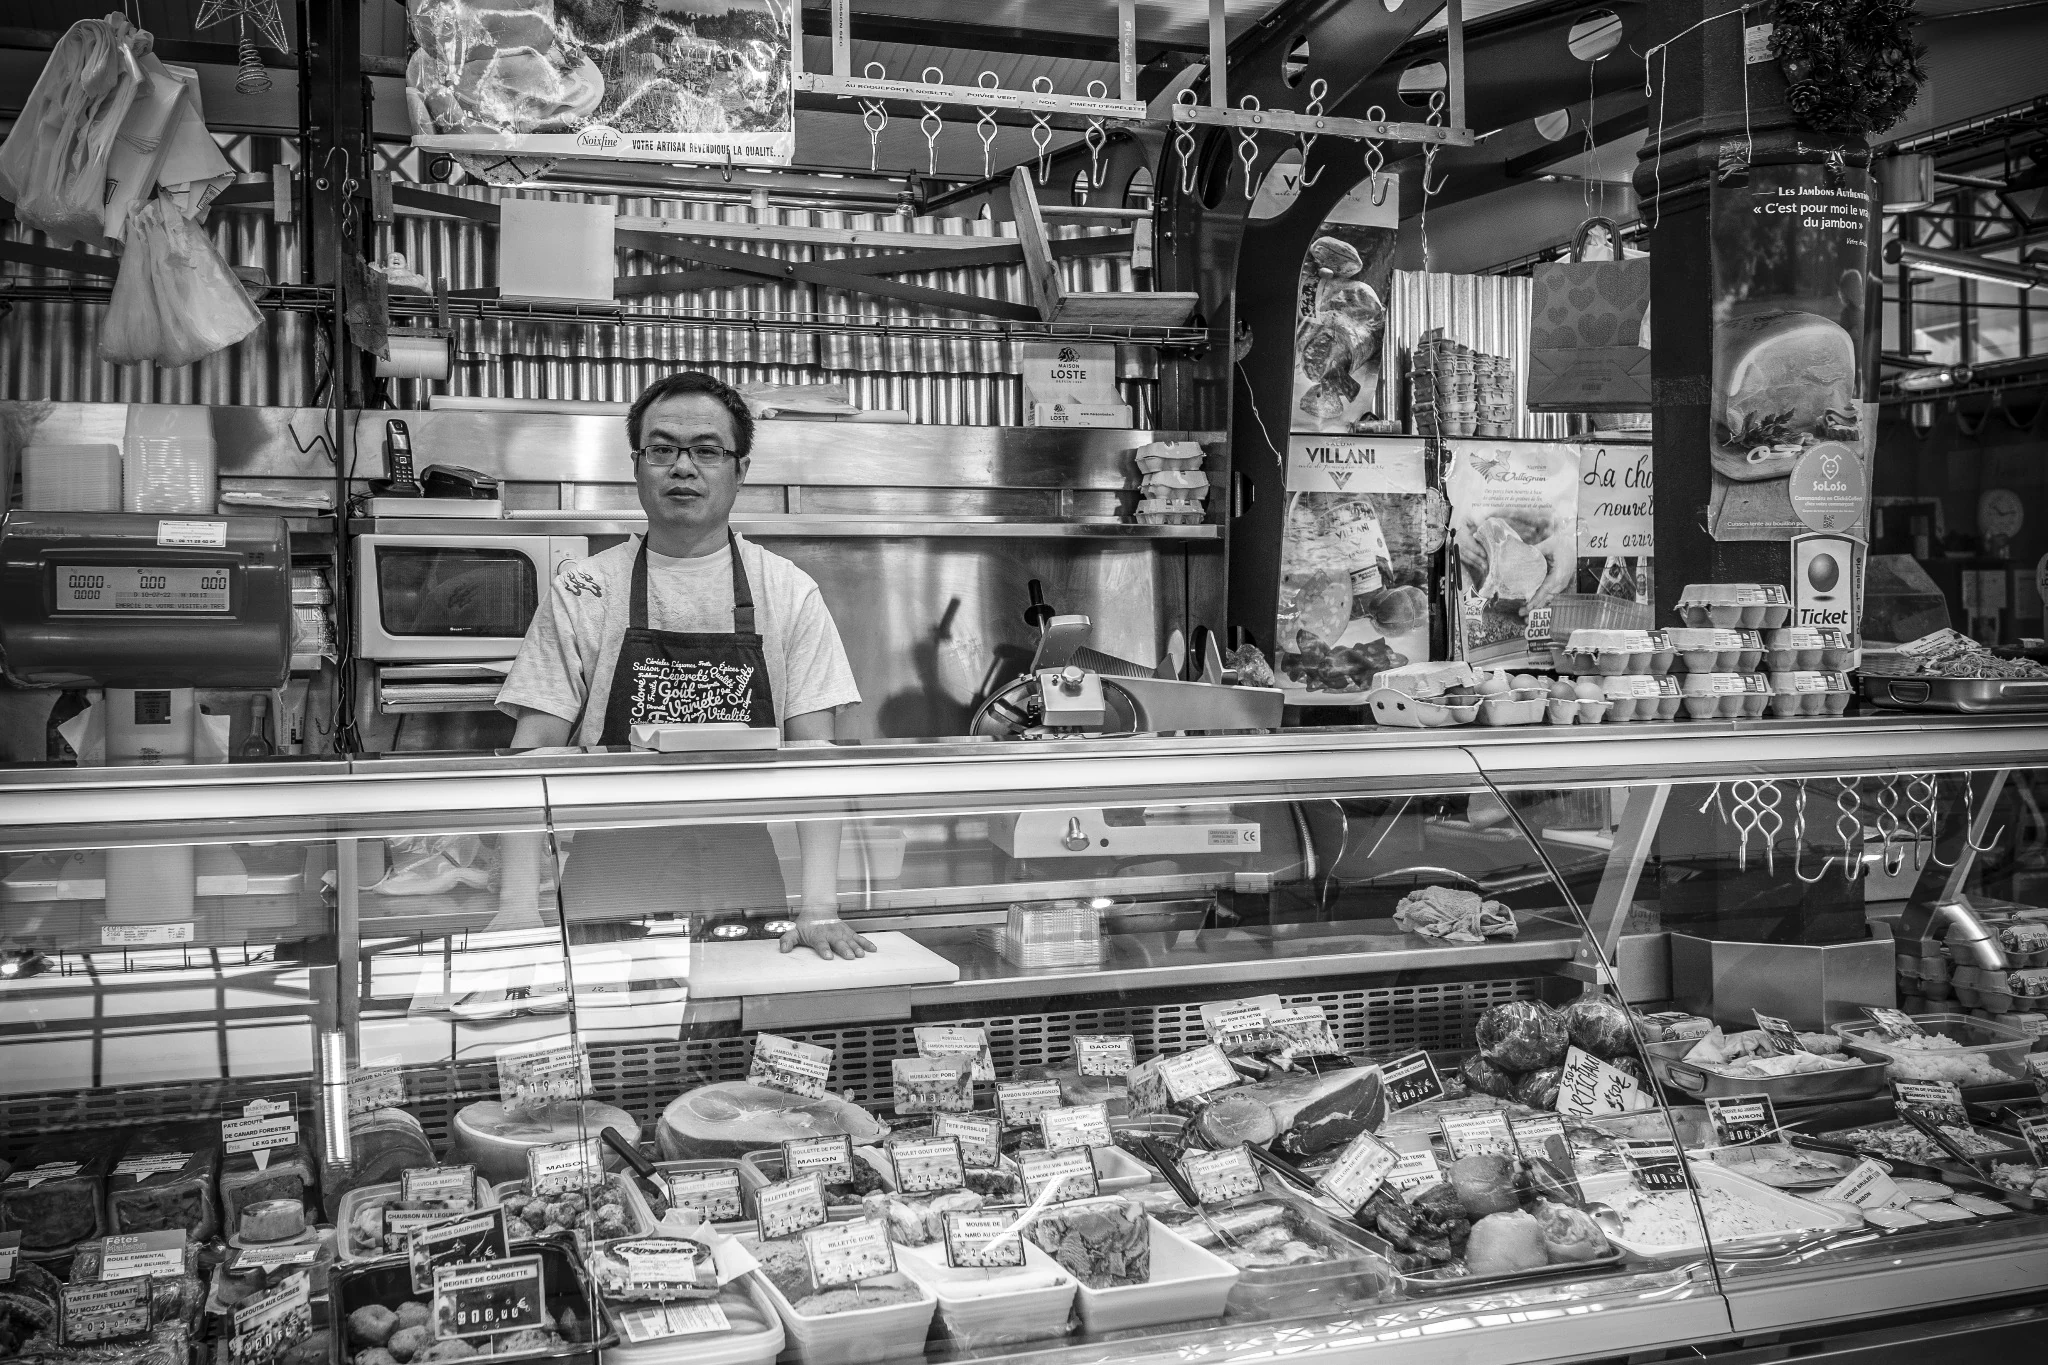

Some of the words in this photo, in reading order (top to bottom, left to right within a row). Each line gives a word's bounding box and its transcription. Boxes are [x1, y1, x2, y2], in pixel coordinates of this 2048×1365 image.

[582, 132, 618, 151] Noixfine
[632, 139, 654, 151] VOTRE
[656, 141, 686, 152] ARTISAN
[689, 144, 730, 155] REVENDIQUE
[733, 145, 743, 156] LA
[1765, 203, 1798, 214] C'est
[1800, 204, 1828, 215] pour
[1830, 204, 1849, 215] moi
[1850, 204, 1858, 216] le
[1803, 216, 1819, 228] du
[1820, 217, 1858, 230] jambon
[1051, 370, 1087, 380] LOSTE
[1305, 447, 1376, 464] VILLANI
[1583, 448, 1616, 489] La
[1588, 531, 1609, 549] est
[1800, 608, 1849, 625] Ticket
[633, 661, 660, 672] Saison
[659, 667, 710, 686] Légèreté
[726, 663, 755, 705] Qualité
[658, 681, 697, 705] Goût
[668, 689, 723, 718] Variété
[707, 707, 752, 722] Vitalité
[1232, 1021, 1262, 1030] EXTRA
[528, 1050, 546, 1058] BLANC
[773, 1048, 794, 1058] JAMBON
[223, 1121, 238, 1129] PATE
[239, 1118, 263, 1127] CROUTE
[1730, 1113, 1763, 1121] MAISON
[233, 1129, 258, 1138] CANARD
[258, 1125, 291, 1134] FORESTIER
[829, 1144, 845, 1152] PORC
[934, 1146, 954, 1154] CITRON
[546, 1160, 588, 1172] MAISON
[797, 1156, 837, 1165] MAISON
[424, 1228, 453, 1241] POMMES
[453, 1220, 490, 1235] DAUPHINES
[106, 1235, 139, 1246] Fêtes
[106, 1255, 129, 1263] ROULE
[130, 1252, 165, 1260] EMMENTAL
[443, 1278, 474, 1288] BEIGNET
[474, 1276, 485, 1284] DE
[486, 1269, 529, 1282] COURGETTE
[68, 1294, 91, 1303] TARTE
[92, 1291, 108, 1300] FINE
[109, 1287, 138, 1297] TOMATE
[80, 1301, 127, 1313] MOZZARELLA
[235, 1301, 265, 1321] CLAFOUTIS
[265, 1297, 276, 1307] AUX
[276, 1285, 300, 1301] CERISES
